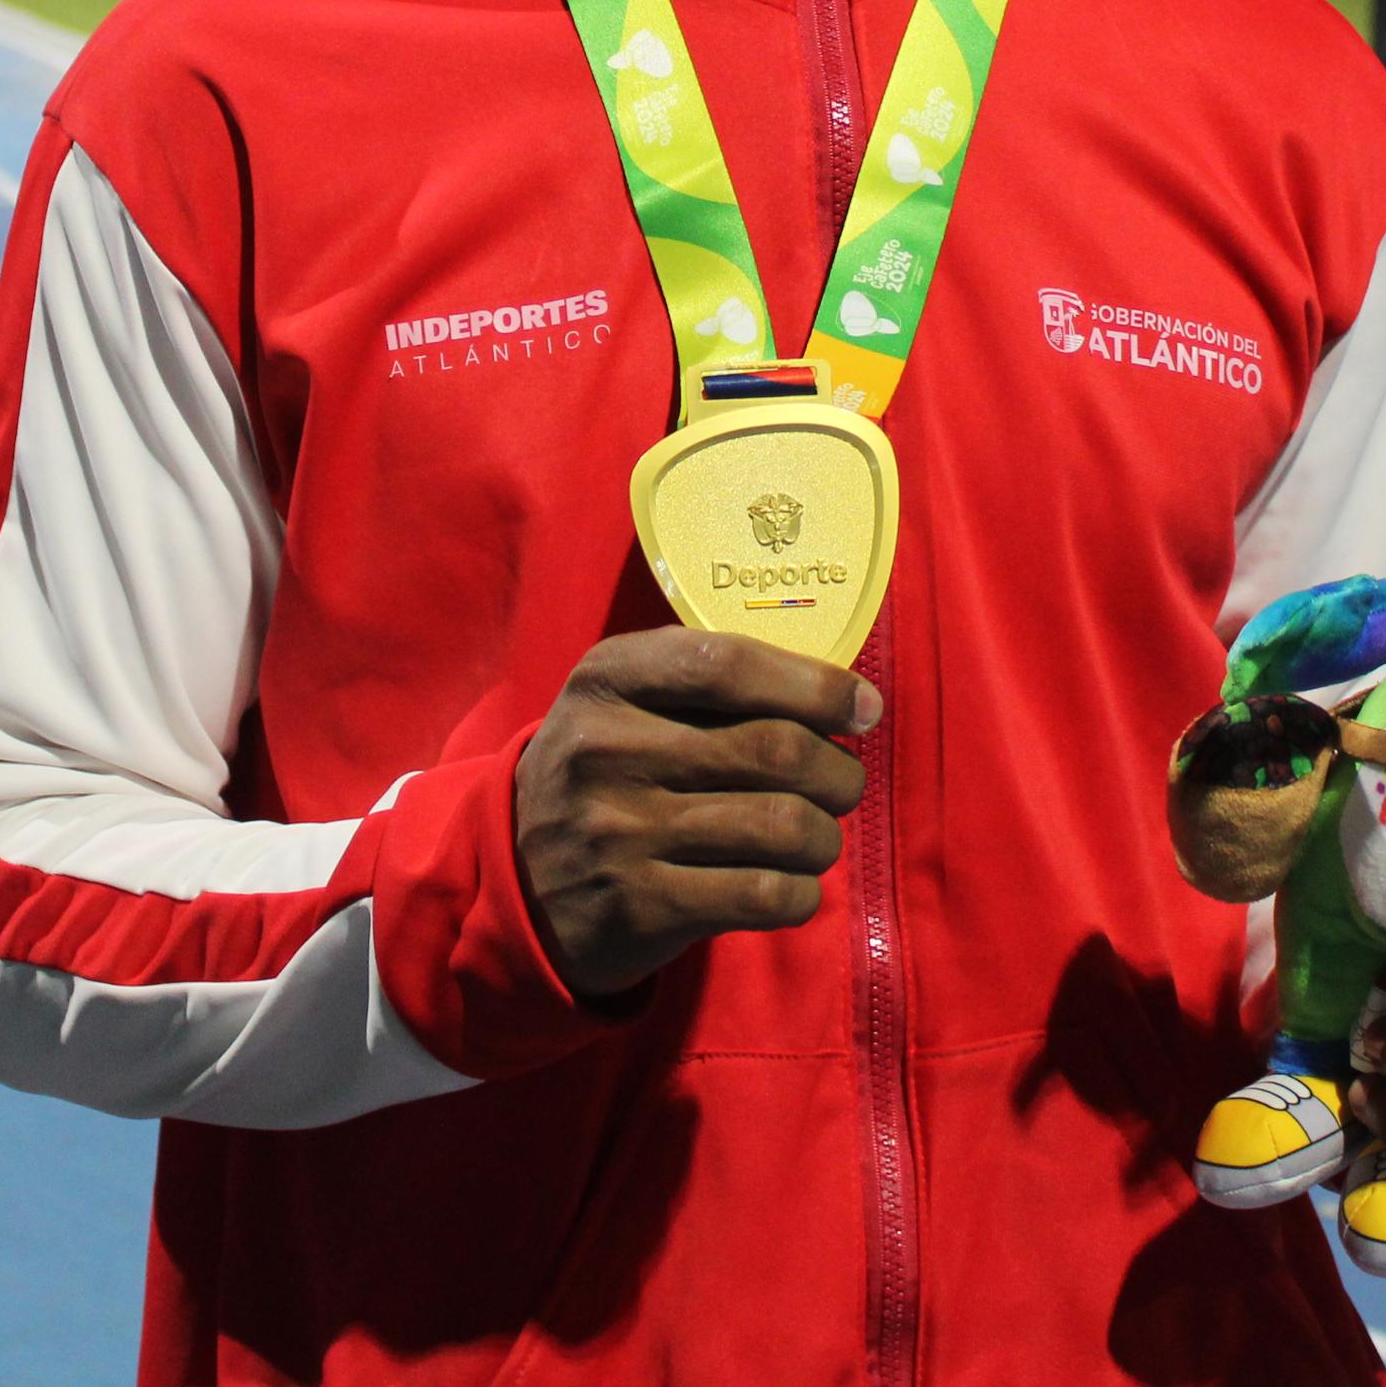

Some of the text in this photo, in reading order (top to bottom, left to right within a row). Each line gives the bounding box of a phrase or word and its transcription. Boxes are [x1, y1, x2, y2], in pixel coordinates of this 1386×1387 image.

[930, 101, 956, 144] 2024
[853, 265, 874, 284] Eje
[885, 251, 913, 294] 2024
[385, 289, 609, 351] INDEPORTES
[388, 324, 611, 379] ATLÁNTICO
[1088, 327, 1262, 395] ATLÁNTICO
[1232, 334, 1262, 360] DEL
[711, 559, 848, 594] Deporte
